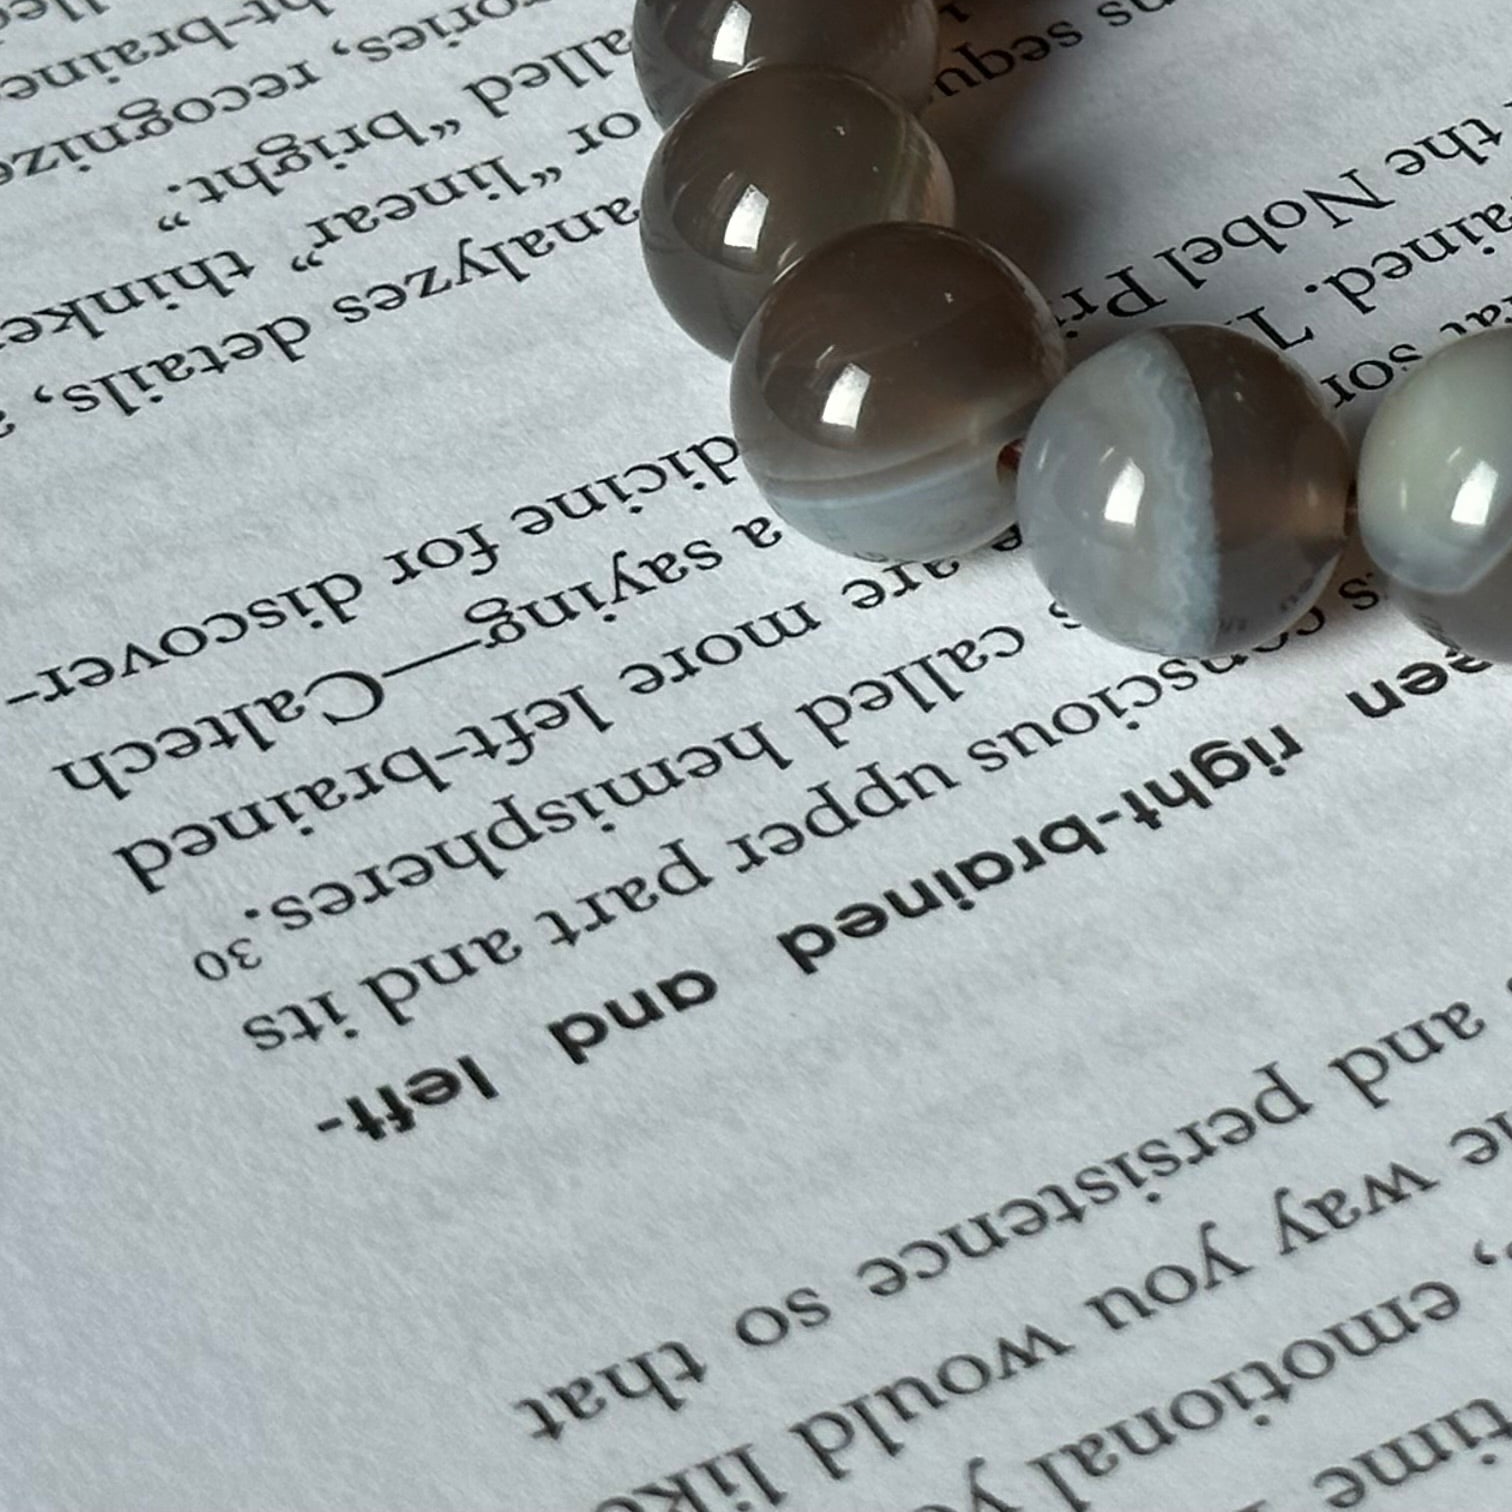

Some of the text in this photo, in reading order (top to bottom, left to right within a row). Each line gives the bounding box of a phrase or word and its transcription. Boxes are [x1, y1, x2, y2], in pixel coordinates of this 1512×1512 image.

[1385, 118, 1503, 176] the
[332, 197, 641, 323] analyzes
[1153, 168, 1396, 290] Nobel
[33, 316, 311, 417] details,
[382, 523, 499, 585] for
[731, 517, 782, 549] a
[6, 573, 363, 705] discover-
[619, 601, 822, 694] more
[795, 626, 1025, 750] called
[112, 685, 614, 895] left-brained
[726, 761, 962, 874] upper
[534, 838, 714, 947] part
[776, 725, 1304, 976] right-brained
[242, 991, 359, 1052] its
[358, 928, 523, 1027] and
[546, 970, 718, 1066] and
[316, 1055, 499, 1142] left-
[1328, 1002, 1486, 1109] and
[856, 1062, 1314, 1297] persistence
[1274, 1163, 1440, 1256] way
[735, 1288, 831, 1347] so
[1084, 1221, 1254, 1332] you
[514, 1342, 707, 1441] that
[788, 1325, 1075, 1481] would
[1026, 1282, 1460, 1512] emotional
